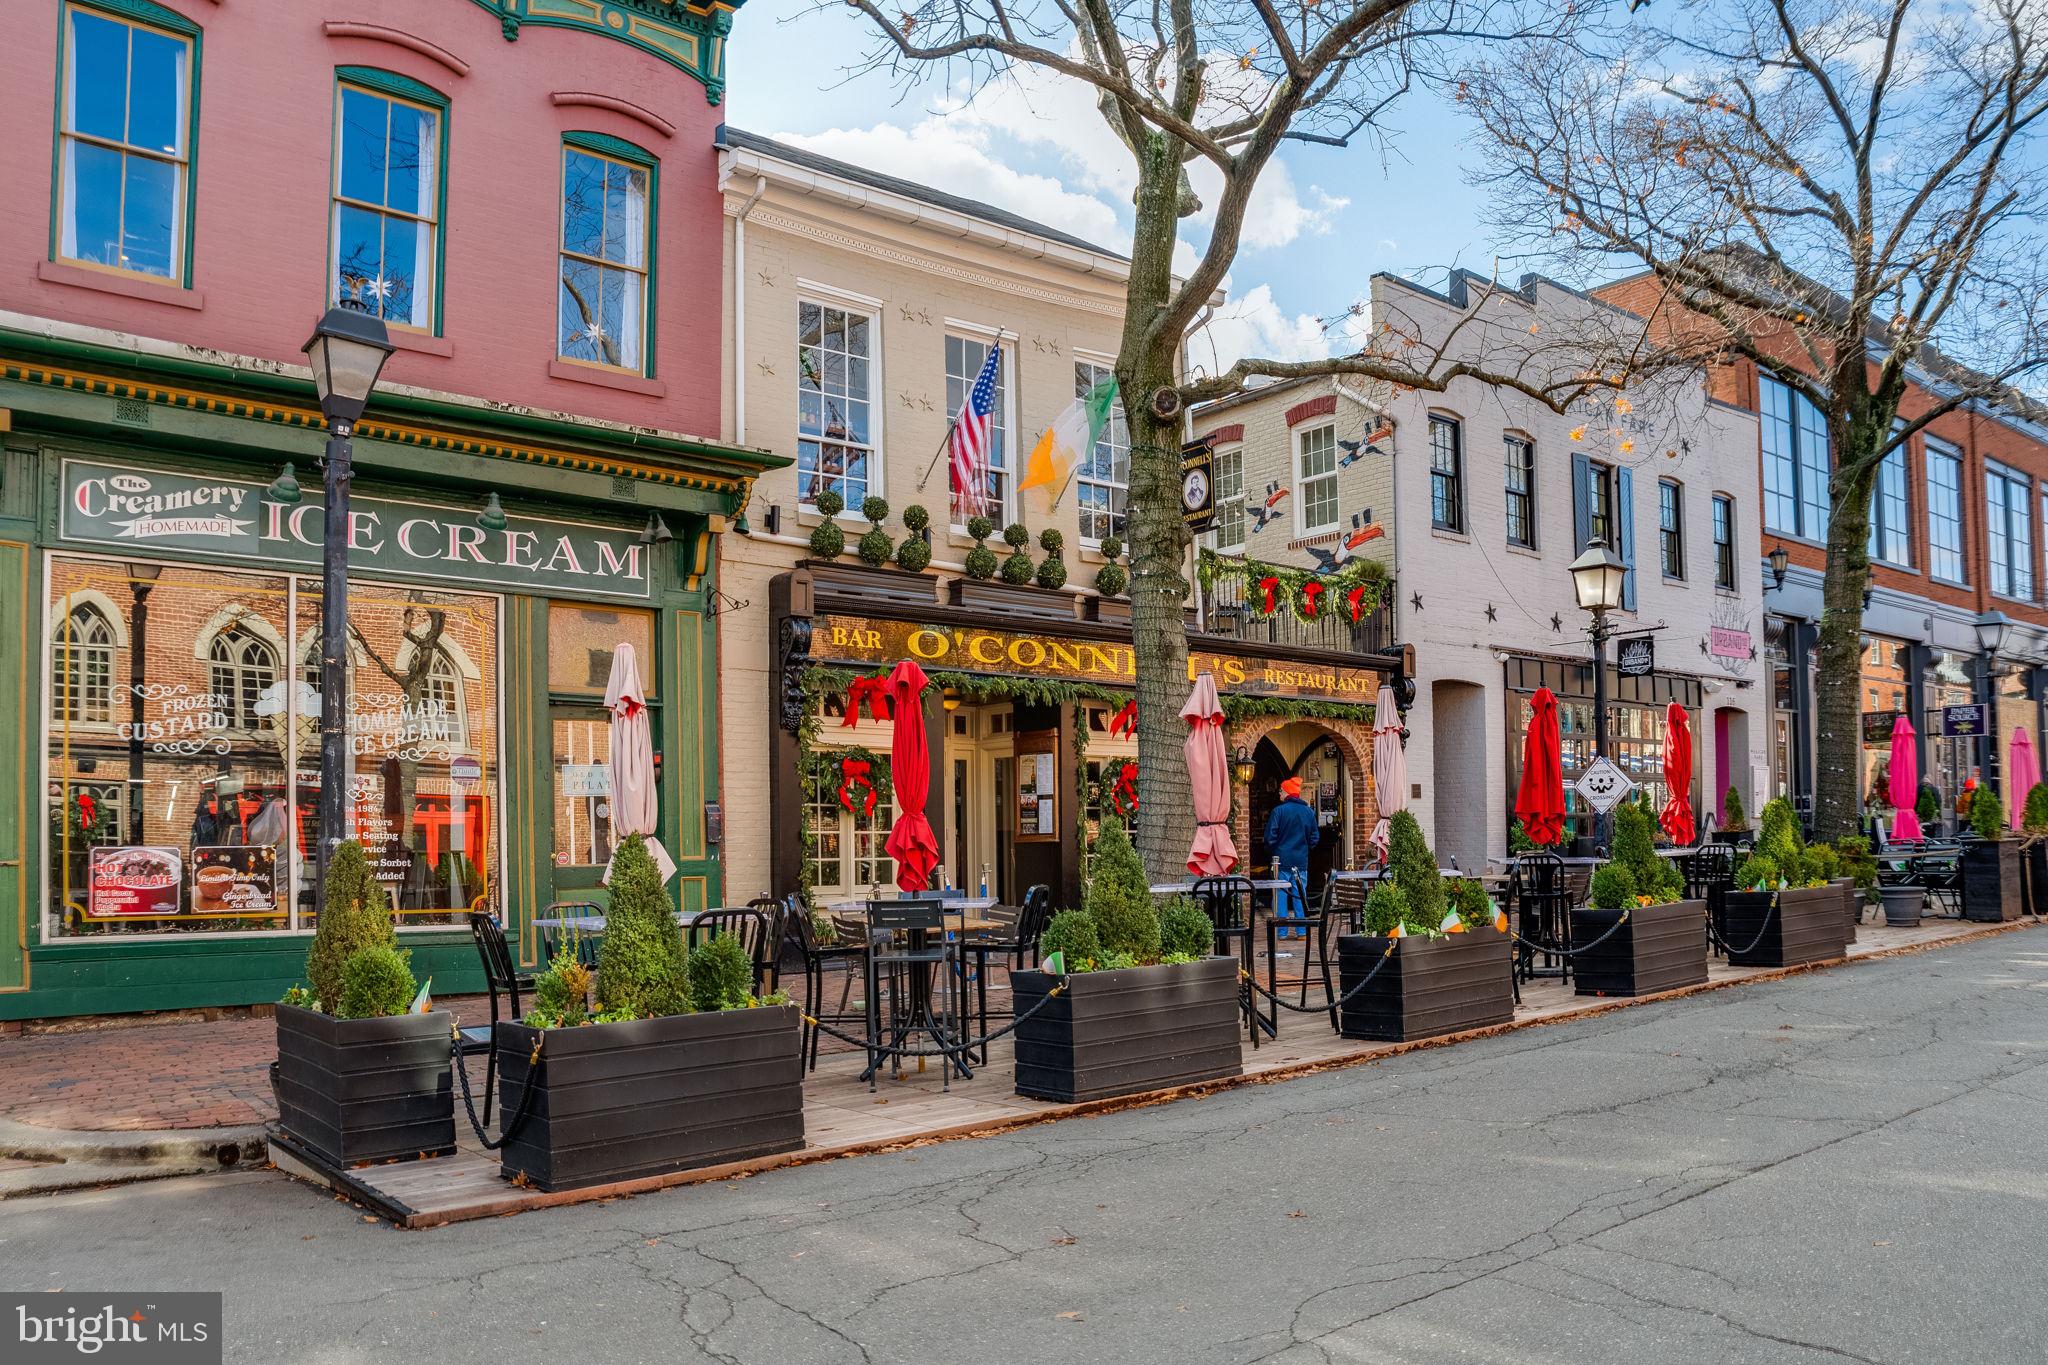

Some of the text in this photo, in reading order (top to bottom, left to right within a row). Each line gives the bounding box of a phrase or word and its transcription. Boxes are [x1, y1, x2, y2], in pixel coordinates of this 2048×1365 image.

[116, 477, 147, 489] The
[74, 478, 249, 518] Creamery
[139, 519, 229, 536] HOMEMADE
[259, 500, 645, 580] ICE CREAM
[831, 627, 883, 650] BAR
[1263, 668, 1370, 693] RESTAURANT
[162, 693, 229, 716] FROZEN
[345, 700, 450, 733] HOMEMADE
[117, 712, 229, 741] CUSTARD
[345, 721, 449, 756] ICE CREAM
[357, 818, 393, 827] Flavors
[362, 831, 399, 842] Seating
[94, 863, 124, 874] HOT
[380, 857, 412, 868] Sorbet
[94, 874, 174, 888] CHOCOLATE
[375, 870, 405, 881] Added
[222, 890, 272, 903] Gingerbread
[245, 900, 272, 909] Cream
